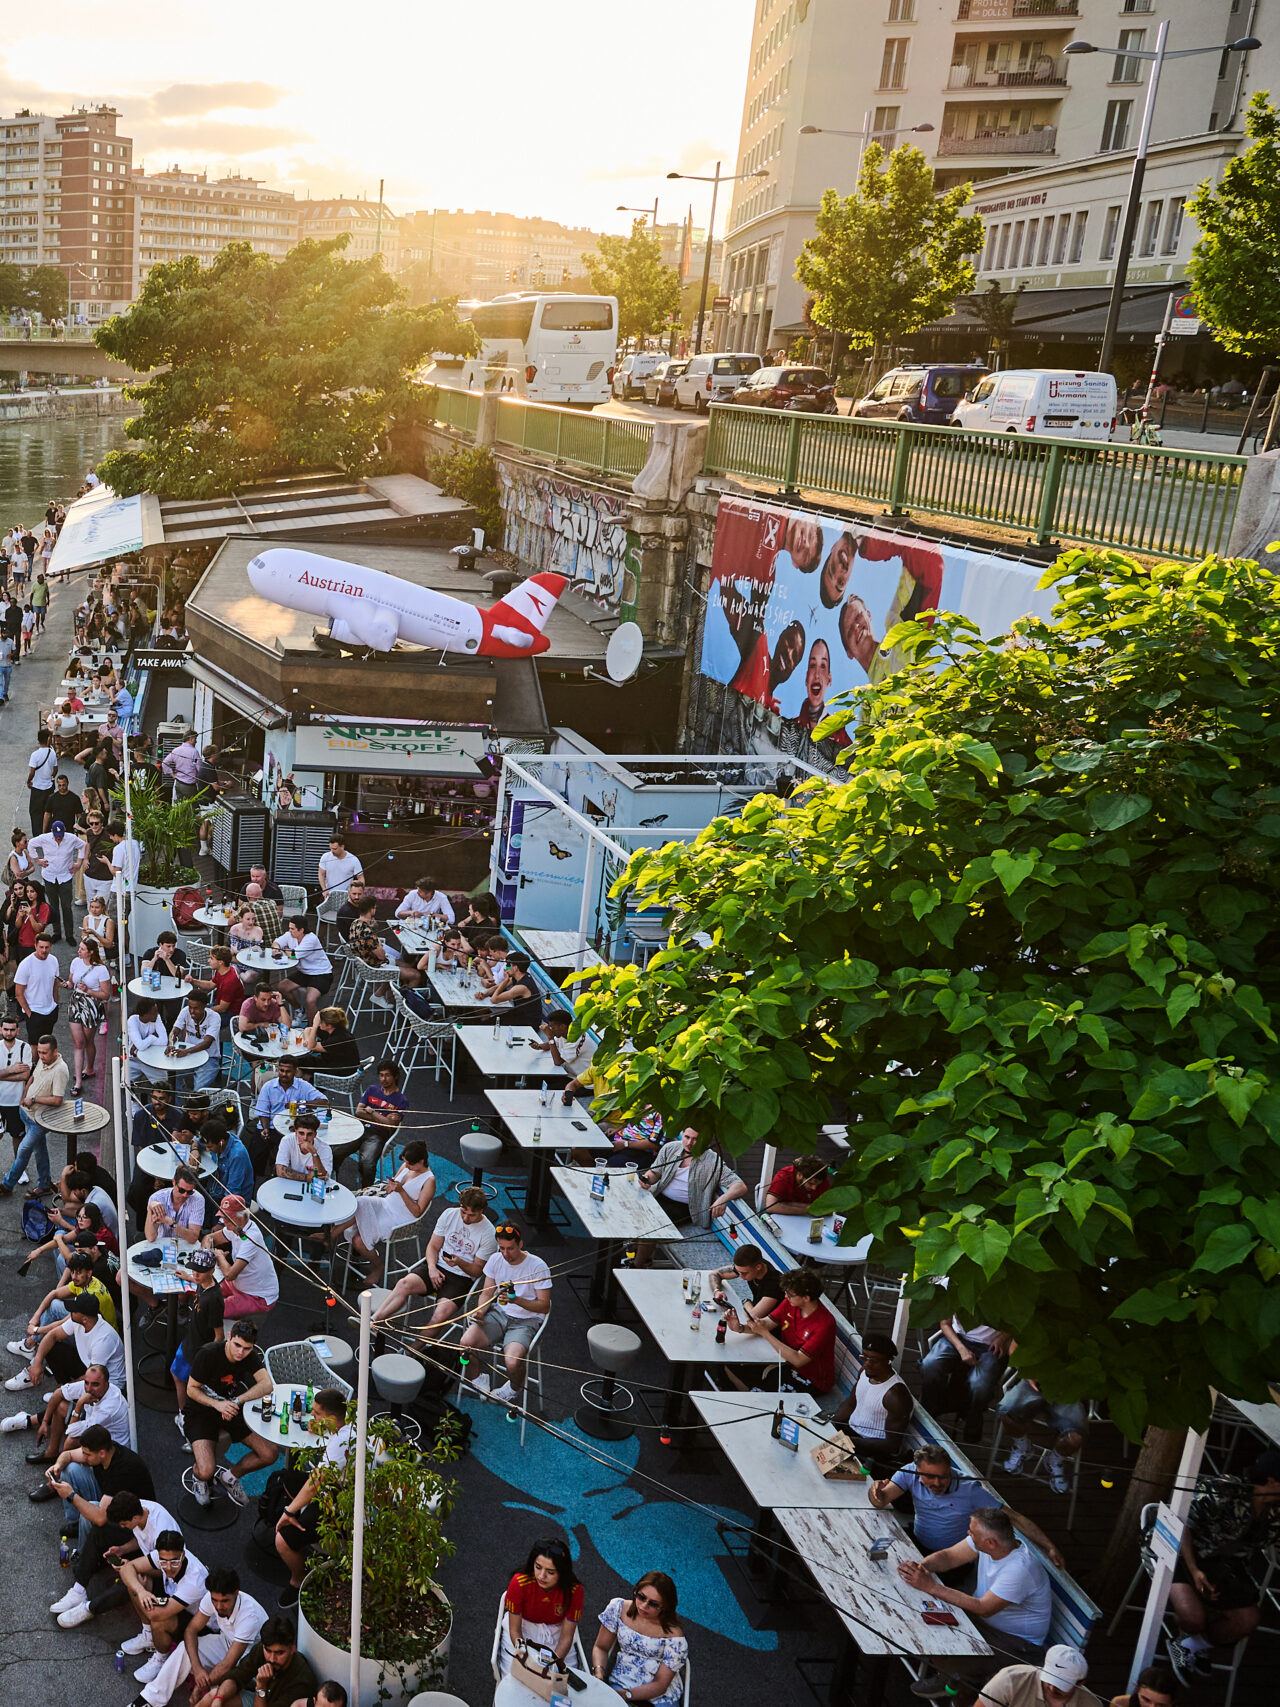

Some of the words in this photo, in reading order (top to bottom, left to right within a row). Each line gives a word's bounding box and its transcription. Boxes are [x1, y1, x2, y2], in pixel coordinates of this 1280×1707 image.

[982, 8, 1008, 17] DOLLS
[1016, 196, 1030, 207] STADT
[1127, 270, 1150, 280] SUSHI
[1049, 380, 1082, 389] Heizung
[1049, 389, 1087, 398] Uhrmann
[298, 570, 364, 598] Austrian
[721, 573, 736, 588] MIT
[712, 594, 727, 608] ZUM
[137, 659, 159, 667] TAKE
